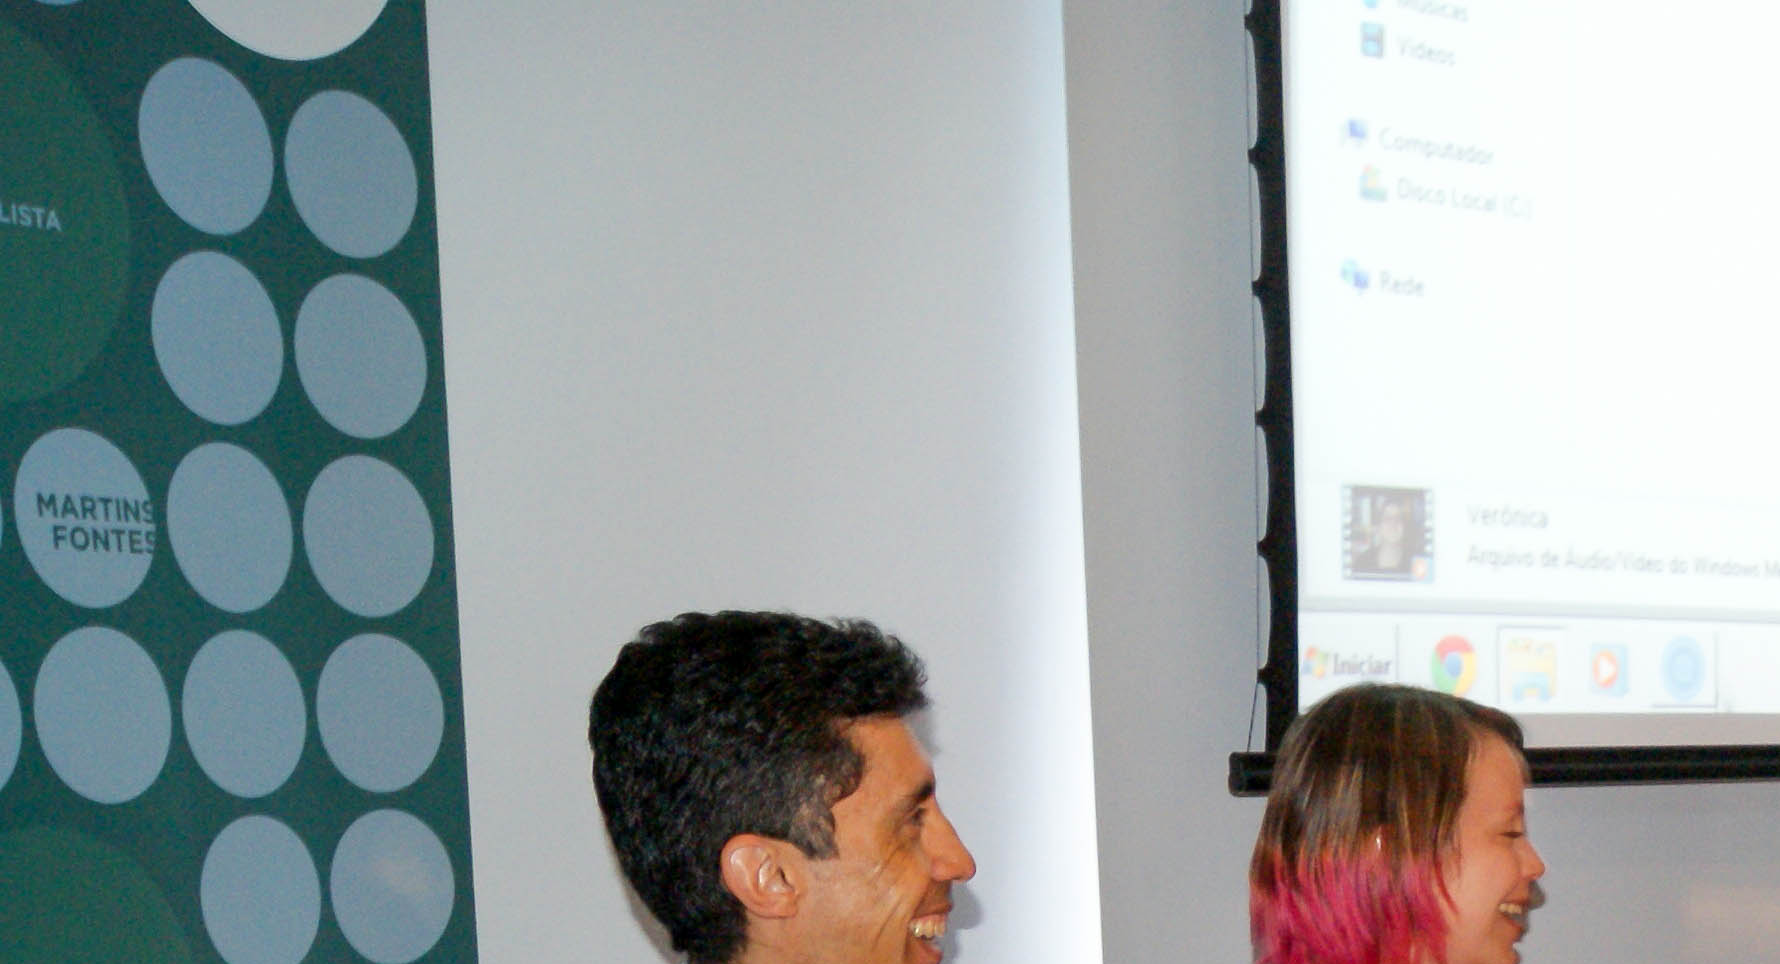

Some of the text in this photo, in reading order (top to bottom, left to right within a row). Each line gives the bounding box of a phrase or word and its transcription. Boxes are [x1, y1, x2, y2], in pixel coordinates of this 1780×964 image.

[36, 492, 154, 525] MARTINS
[52, 525, 155, 554] FONTES
[1333, 653, 1391, 677] Iniciar
